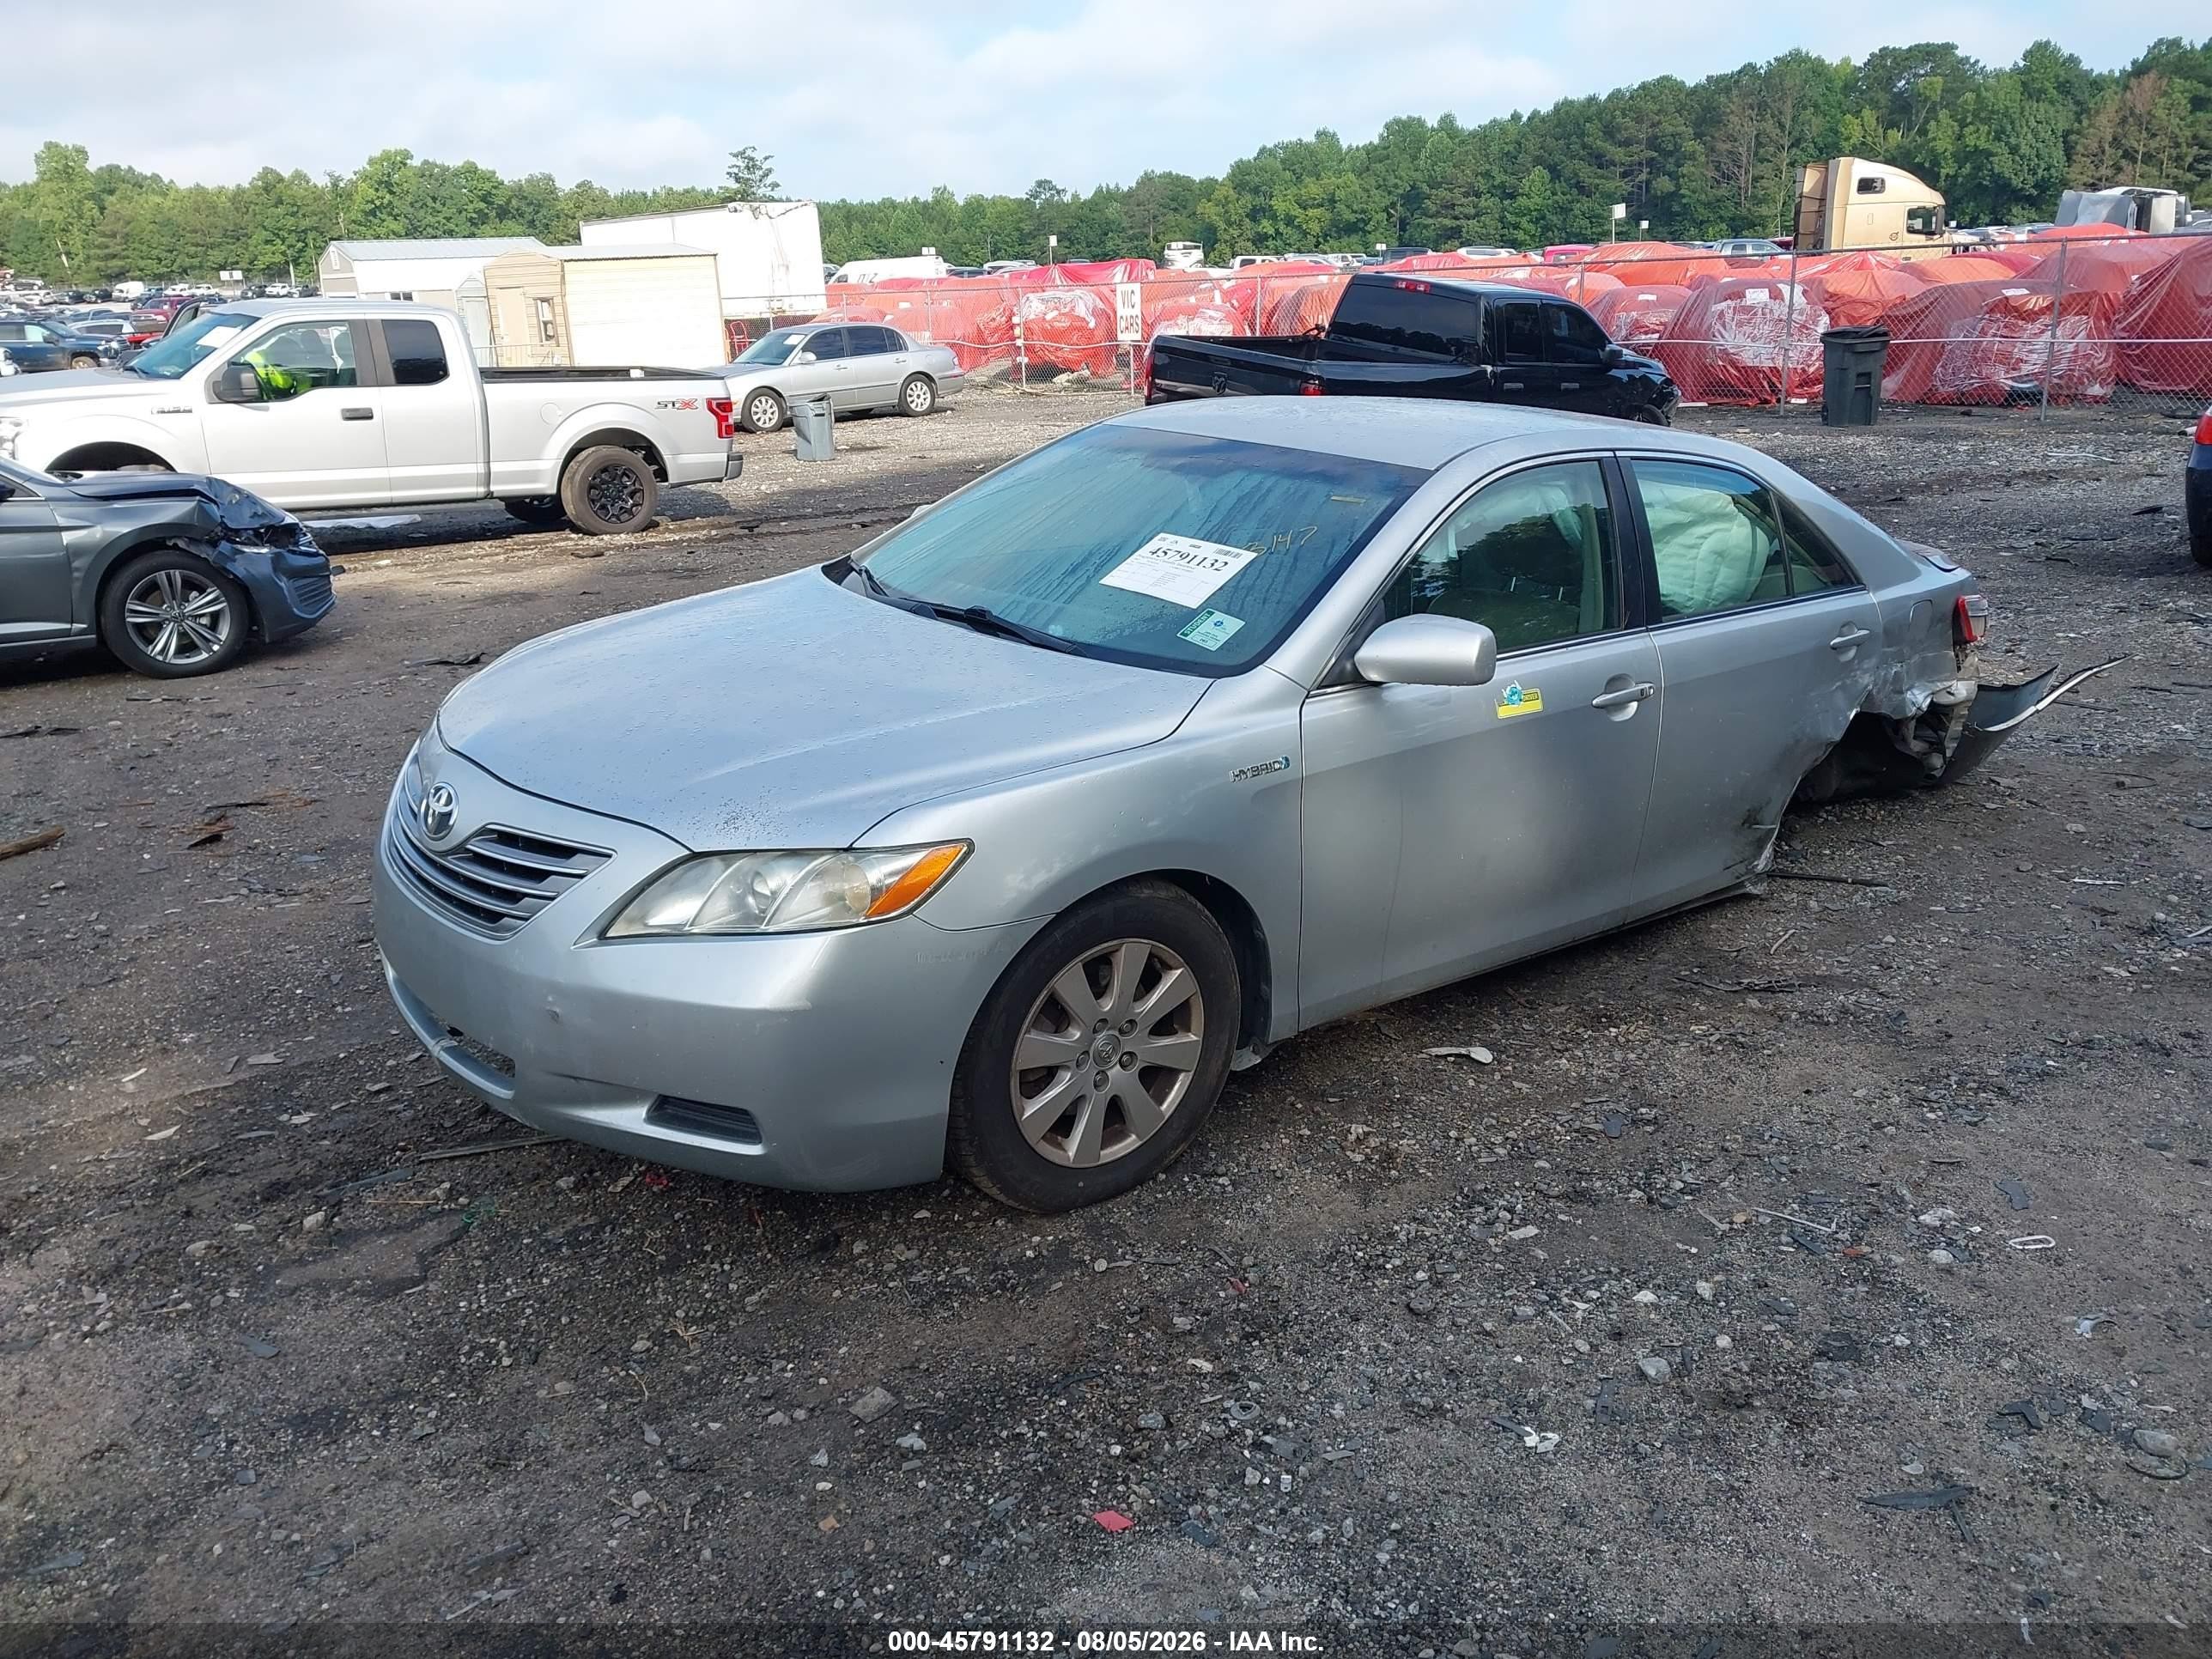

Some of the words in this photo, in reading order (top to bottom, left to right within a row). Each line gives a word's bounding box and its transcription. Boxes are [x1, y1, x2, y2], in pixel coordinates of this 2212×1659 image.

[1121, 289, 1136, 309] VIC
[1119, 313, 1139, 335] CARS
[654, 398, 699, 410] STX
[1149, 546, 1229, 572] 45791132
[1183, 612, 1211, 635] STUDENT
[1229, 758, 1282, 783] HYBRID
